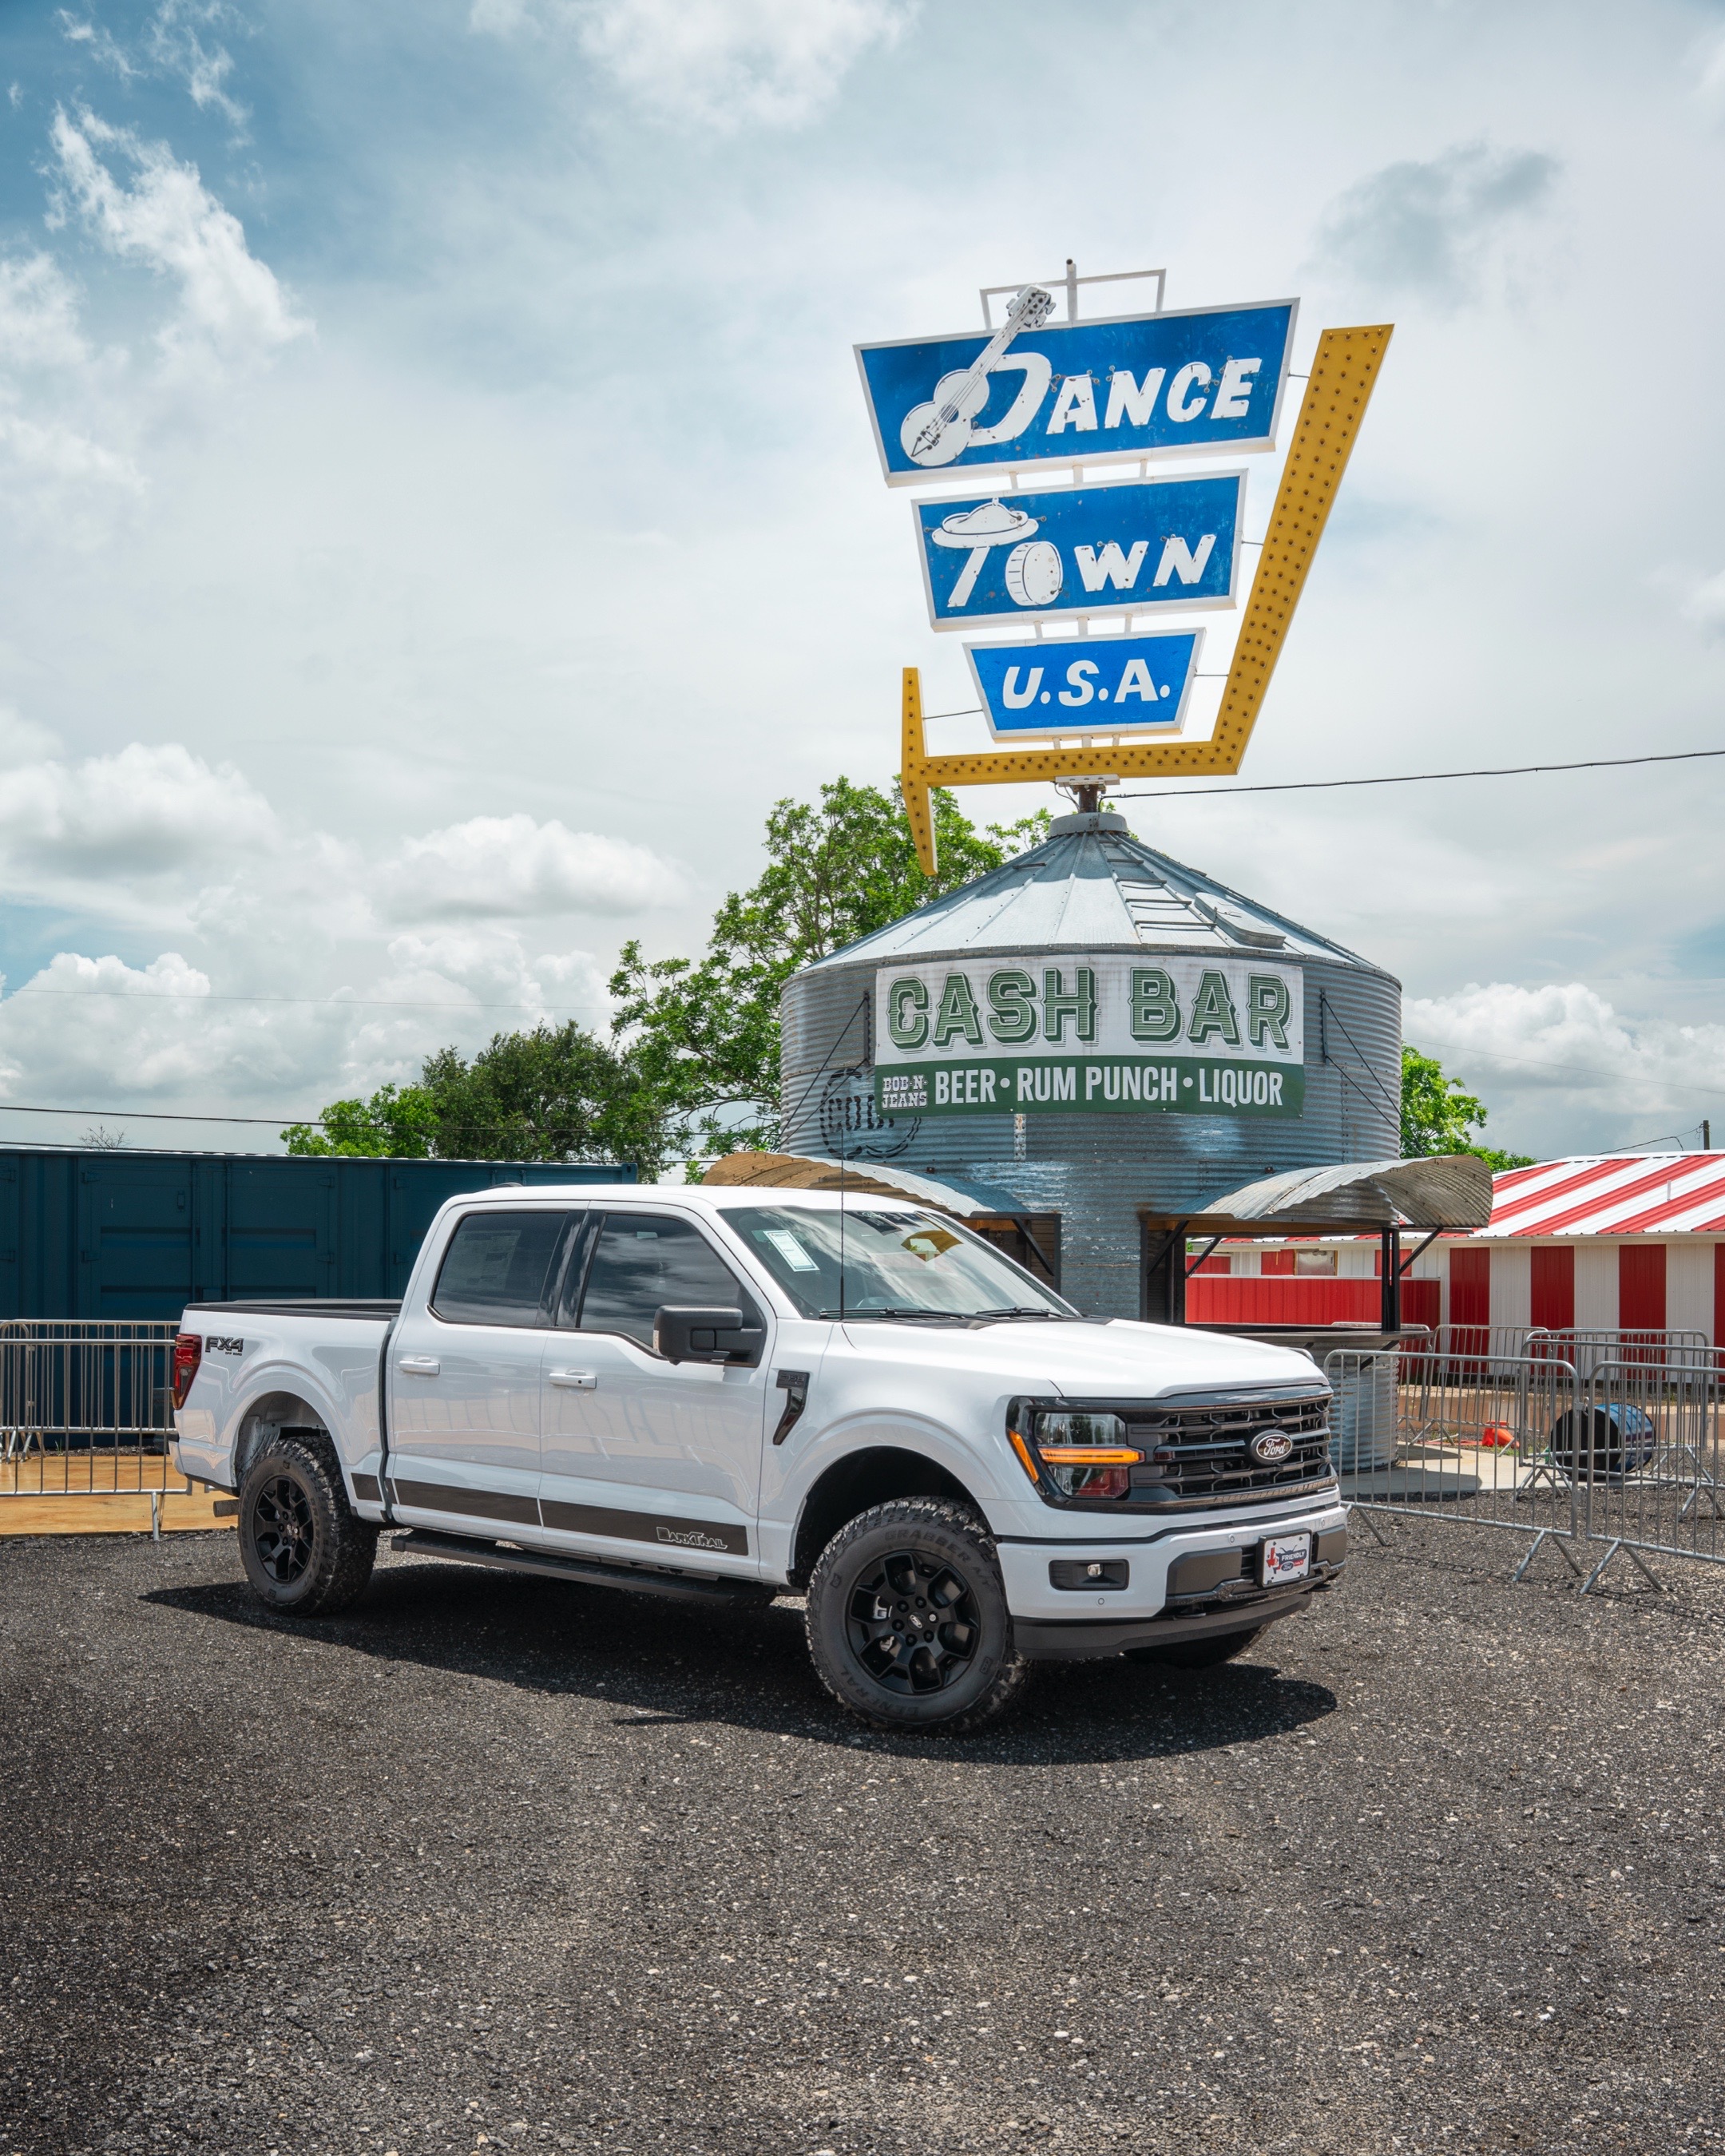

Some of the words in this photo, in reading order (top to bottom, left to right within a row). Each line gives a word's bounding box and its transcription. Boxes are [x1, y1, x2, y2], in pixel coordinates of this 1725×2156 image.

[901, 351, 1263, 466] DANCE
[933, 498, 1215, 606] TOWN
[1002, 659, 1170, 709] U.S.A.
[886, 966, 1100, 1052] CASH
[1128, 966, 1292, 1052] BAR
[882, 1092, 927, 1108] JEANS
[935, 1068, 996, 1104] BEER
[1017, 1067, 1076, 1101] RUM
[1085, 1066, 1177, 1101] PUNCH
[1199, 1068, 1283, 1108] LIQUOR
[204, 1335, 244, 1353] FX4
[1263, 1438, 1287, 1456] Ford
[1281, 1551, 1306, 1562] FRIENDLY
